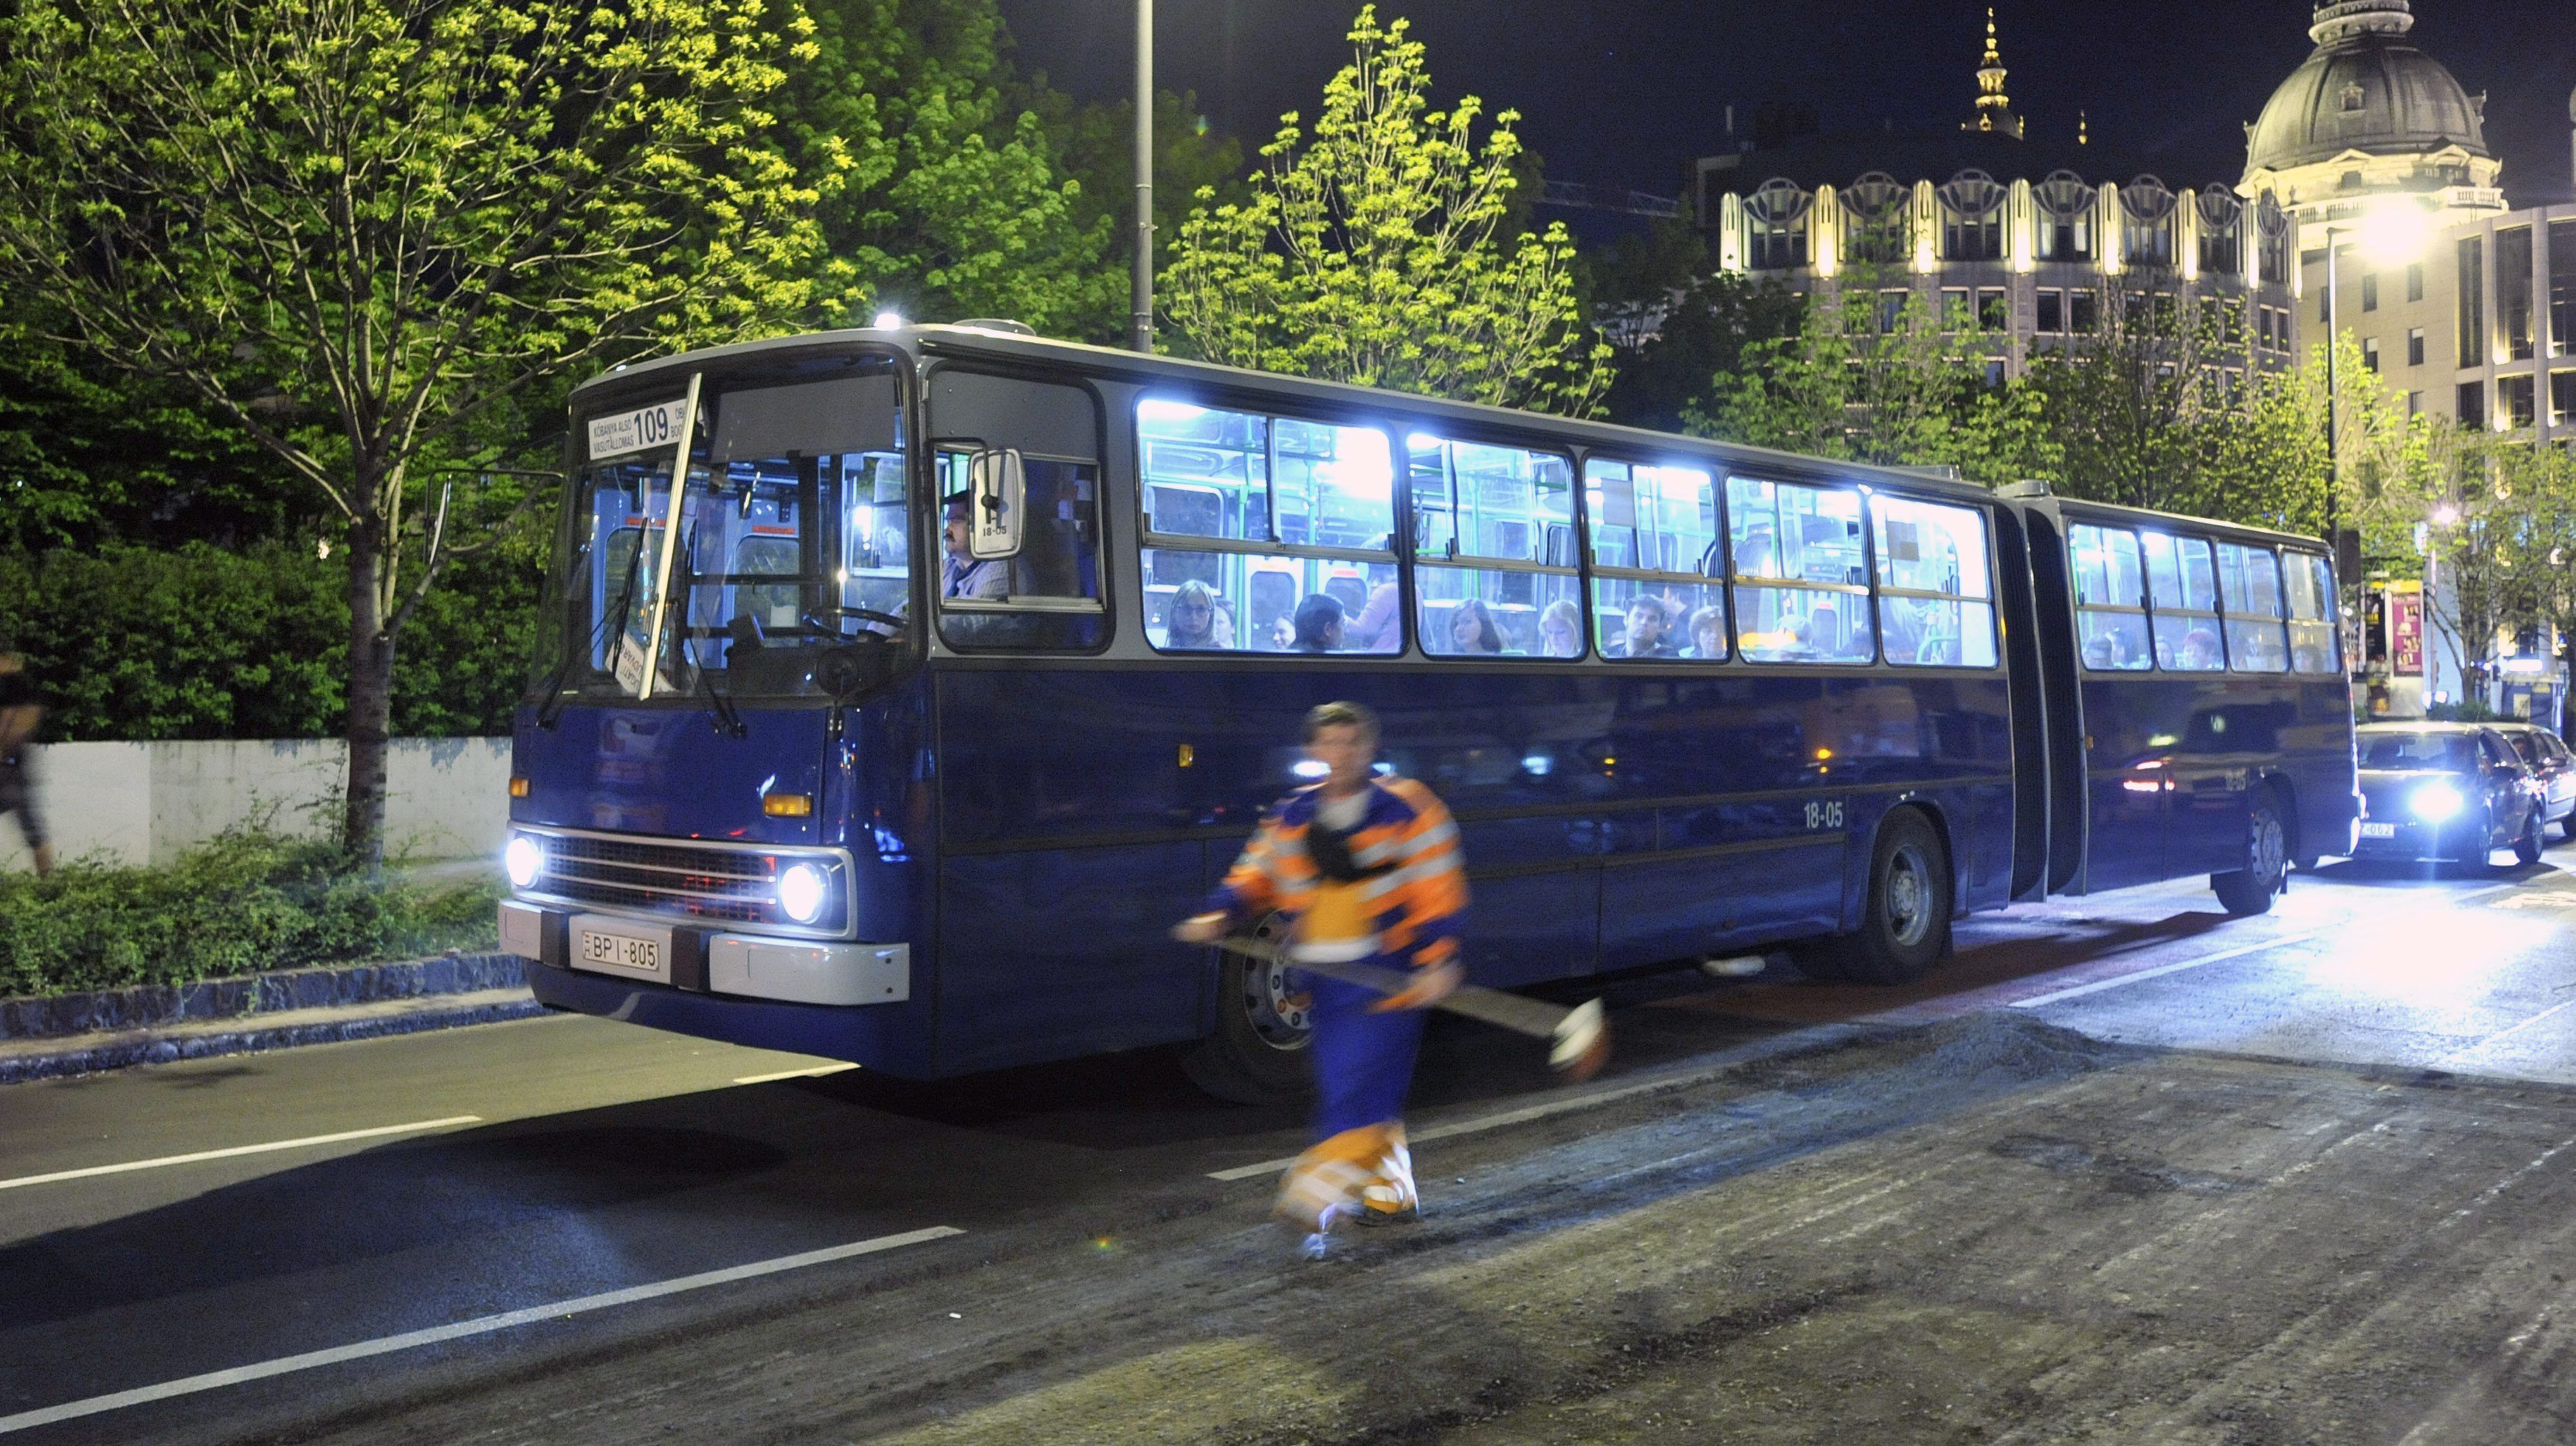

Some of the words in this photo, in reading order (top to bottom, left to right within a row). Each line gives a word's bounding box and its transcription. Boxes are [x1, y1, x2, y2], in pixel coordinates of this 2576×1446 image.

[634, 407, 668, 445] 109
[983, 525, 1007, 537] 18-05
[1803, 801, 1844, 829] 18-05
[593, 936, 656, 967] BPI-805
